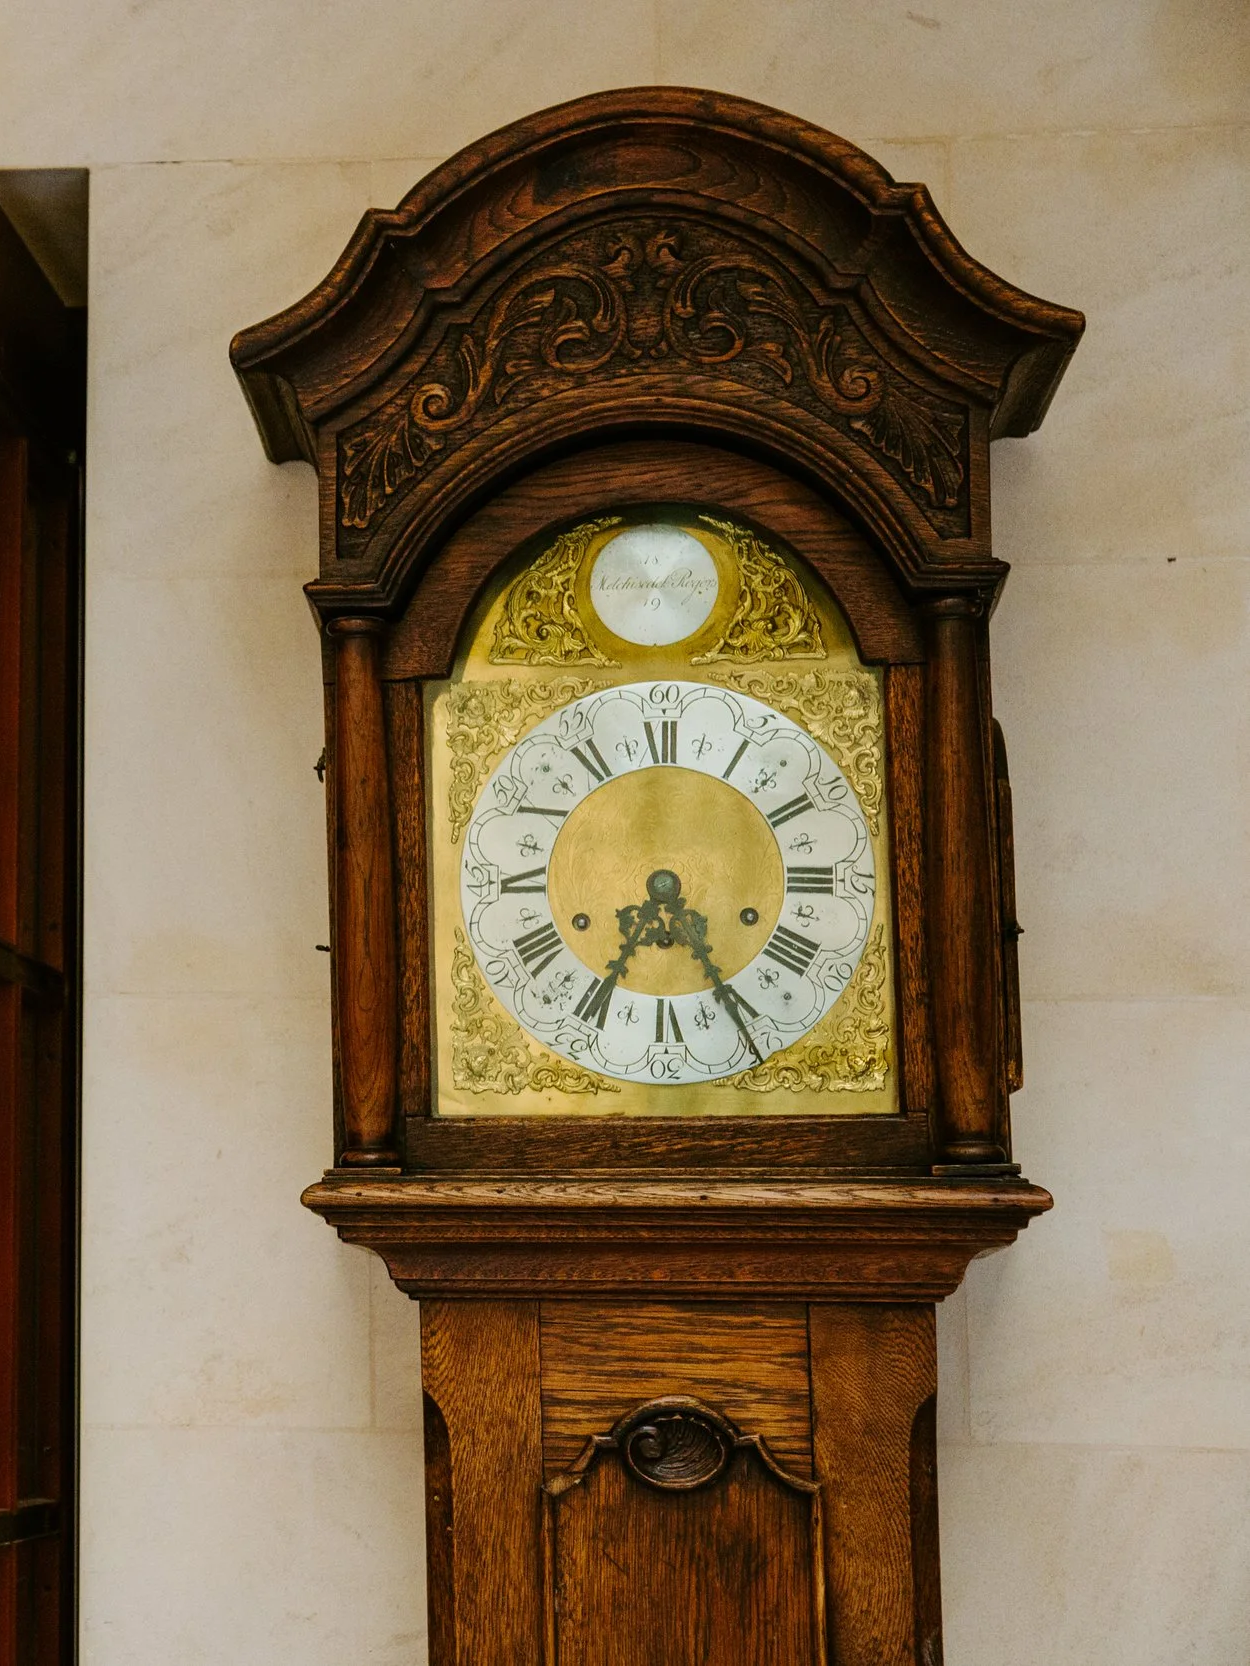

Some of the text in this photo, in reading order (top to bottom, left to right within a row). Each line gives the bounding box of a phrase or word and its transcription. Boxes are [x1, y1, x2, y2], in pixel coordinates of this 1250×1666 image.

[649, 684, 680, 705] 60
[558, 702, 585, 737] 55
[746, 713, 779, 729] 5
[639, 720, 678, 767] XII
[722, 738, 751, 780] I
[570, 738, 614, 792] XI
[492, 774, 515, 805] 50
[817, 776, 849, 801] 10
[517, 795, 570, 830] X
[766, 792, 815, 830] II
[464, 860, 490, 898] 45
[500, 865, 547, 896] IX
[786, 865, 834, 896] III
[850, 864, 876, 898] 15
[512, 921, 568, 979] VIII
[761, 924, 822, 979] IIII
[485, 960, 515, 989] 40
[823, 963, 853, 992] 20
[654, 998, 685, 1043] VI
[545, 1030, 590, 1061] 35
[650, 1057, 685, 1080] 30
